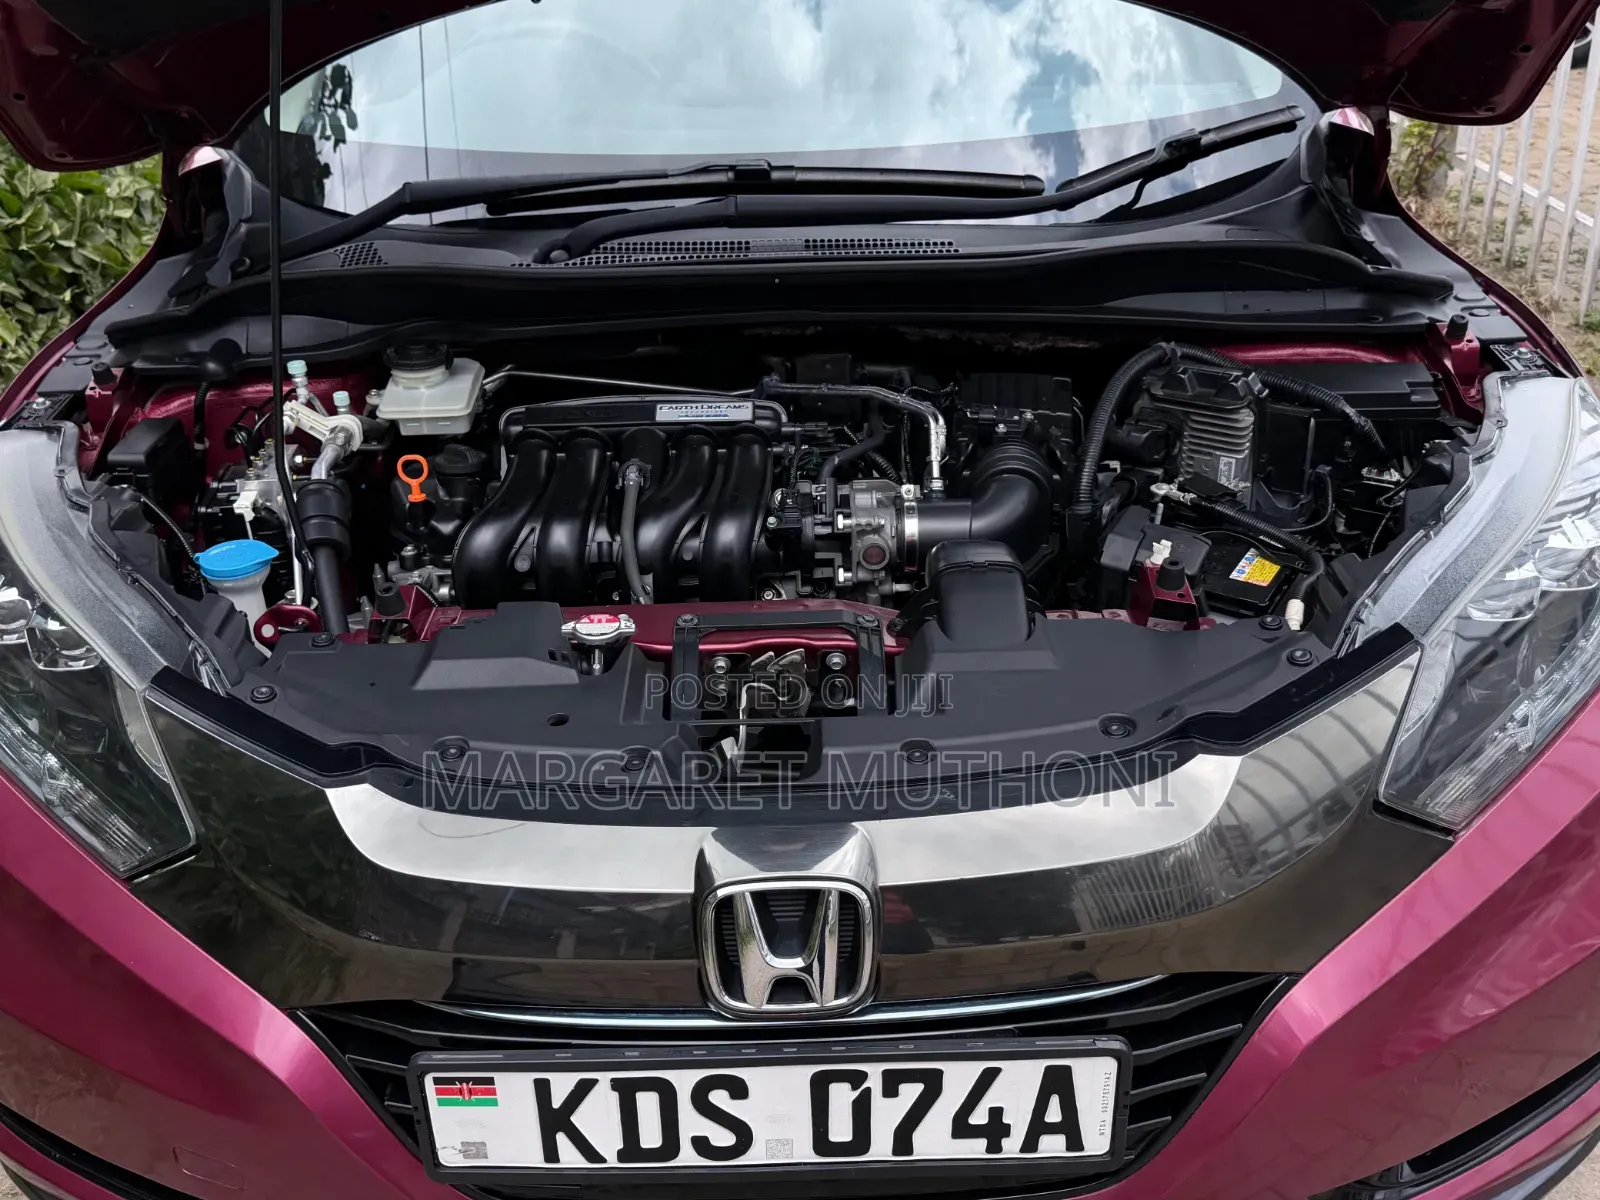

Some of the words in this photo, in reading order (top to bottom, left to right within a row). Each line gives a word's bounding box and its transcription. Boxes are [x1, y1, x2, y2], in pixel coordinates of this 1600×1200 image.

[532, 1073, 754, 1164] KDS
[810, 1065, 1085, 1158] 074A
[1099, 1119, 1107, 1136] NTSA
